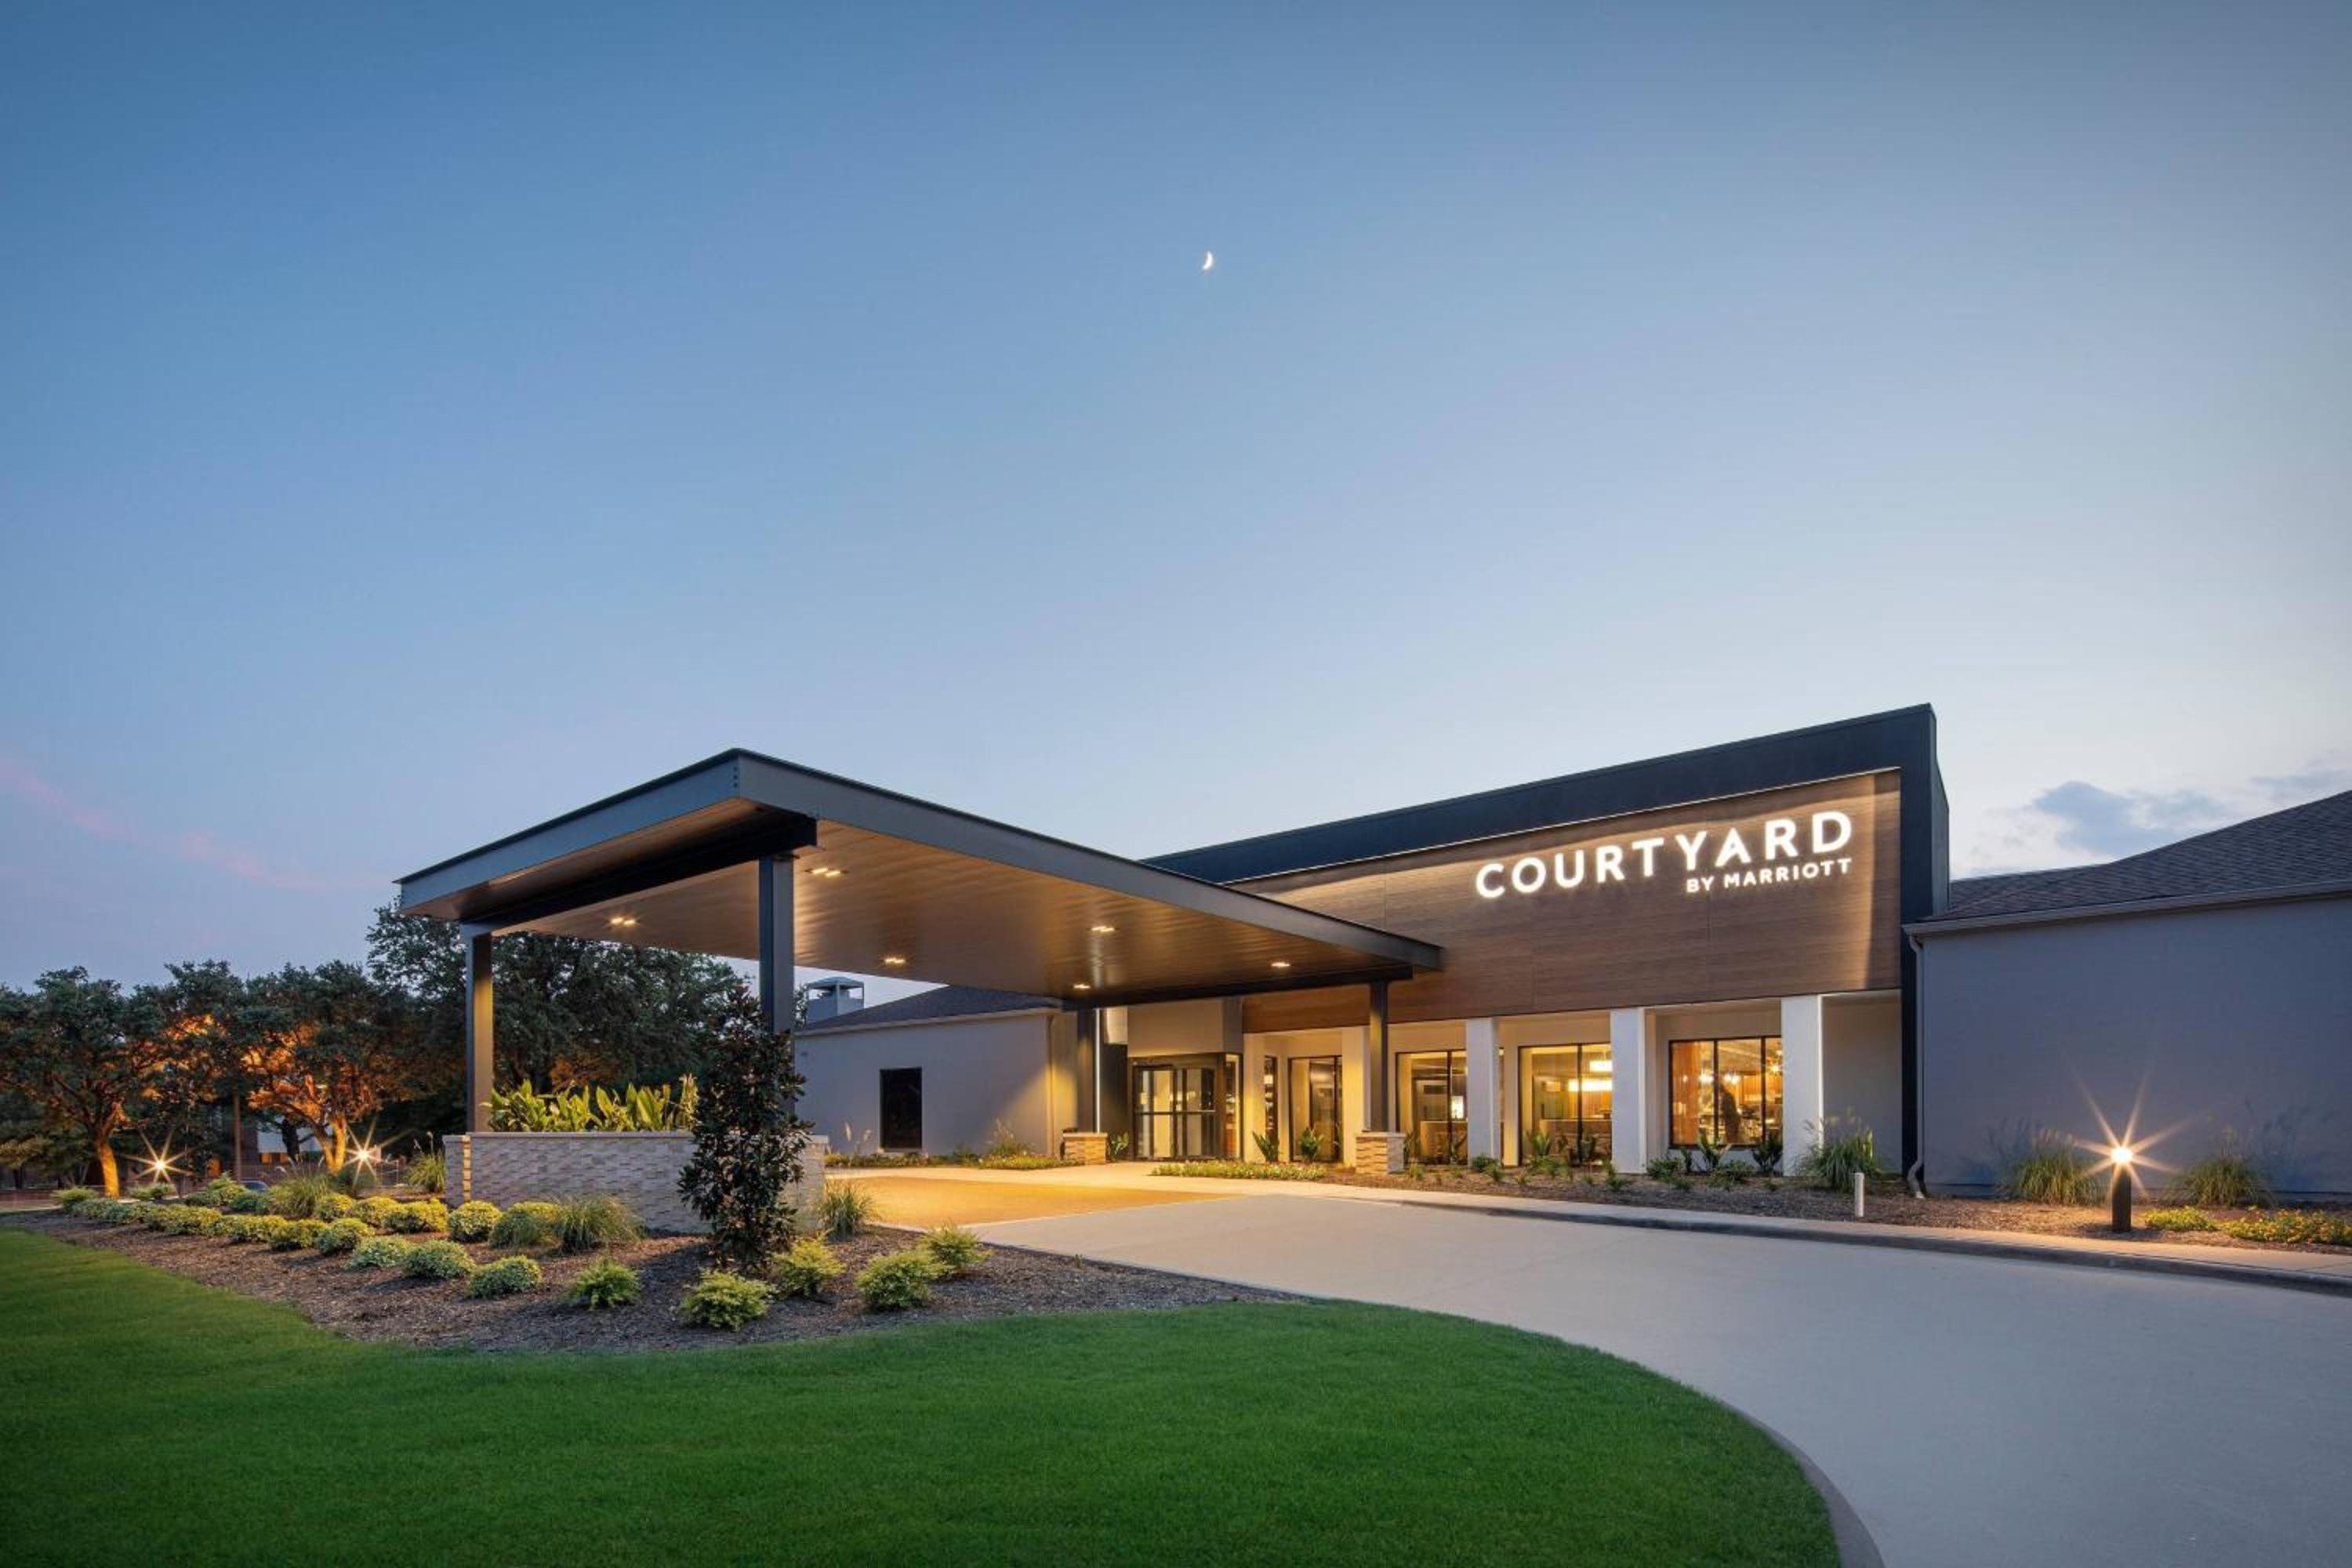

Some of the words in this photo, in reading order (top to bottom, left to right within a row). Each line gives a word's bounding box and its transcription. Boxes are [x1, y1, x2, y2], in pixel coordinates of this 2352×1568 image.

[1475, 811, 1853, 898] COURTYARD
[1686, 876, 1715, 893] BY
[1723, 858, 1852, 888] MARRIOTT
